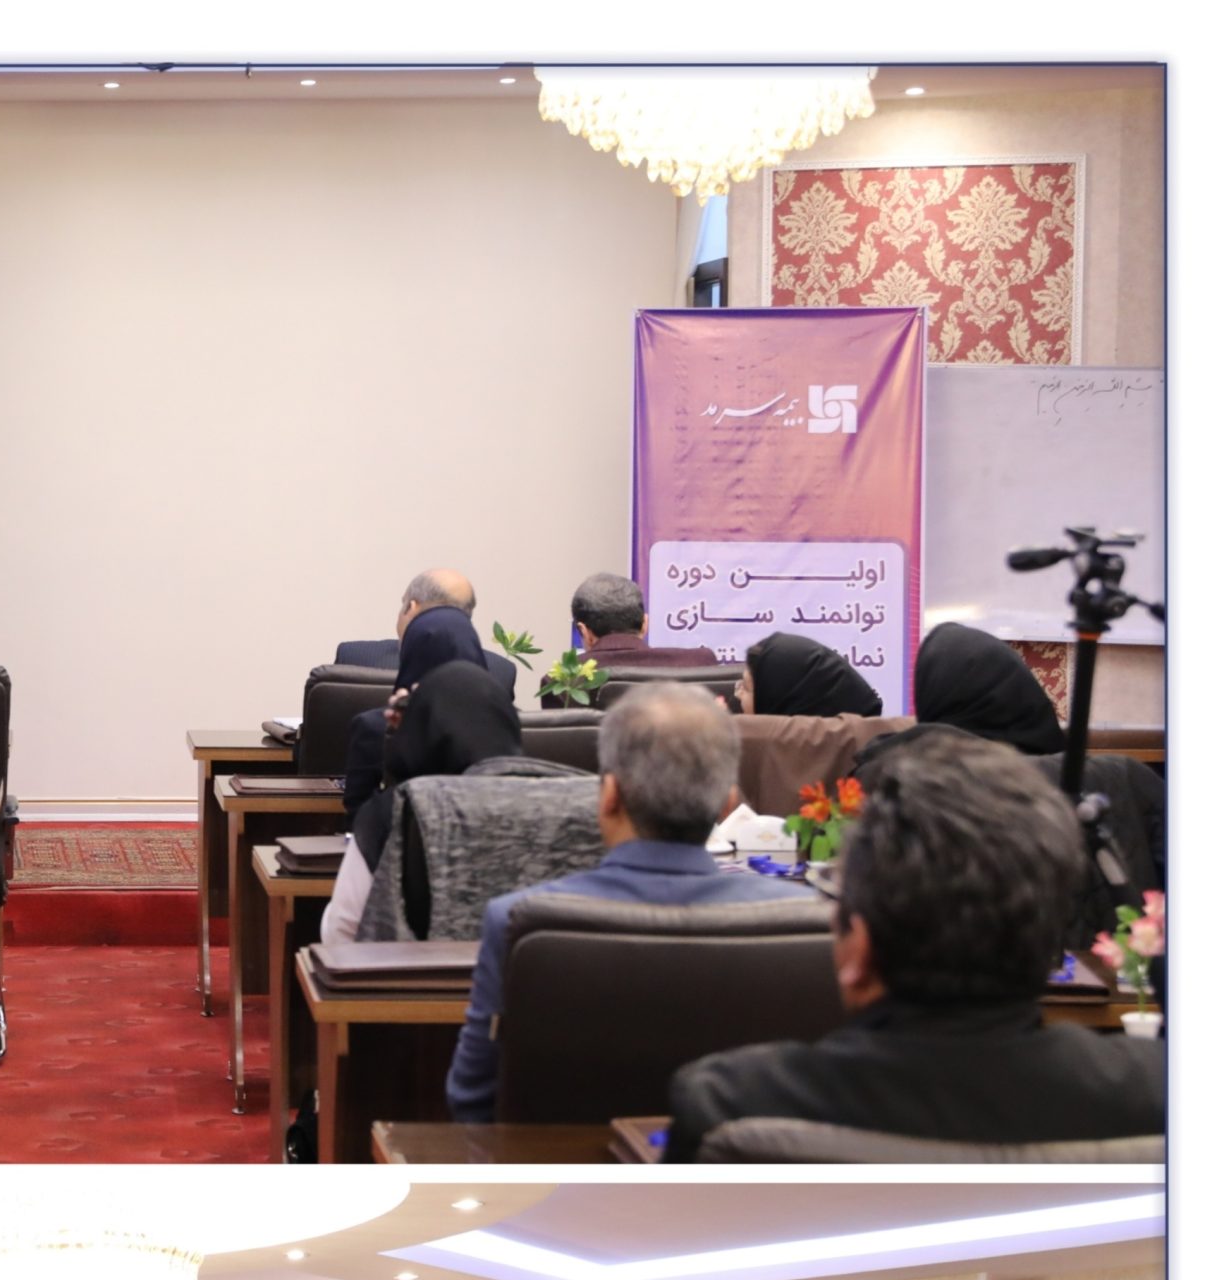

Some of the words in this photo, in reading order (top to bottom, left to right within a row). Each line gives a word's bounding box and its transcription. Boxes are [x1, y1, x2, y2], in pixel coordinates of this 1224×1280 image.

[699, 392, 786, 425] سرمد
[772, 397, 804, 427] بیمه
[667, 562, 716, 588] دوره
[730, 559, 885, 590] اولین
[666, 601, 774, 631] سازی
[791, 603, 885, 632] توانمند
